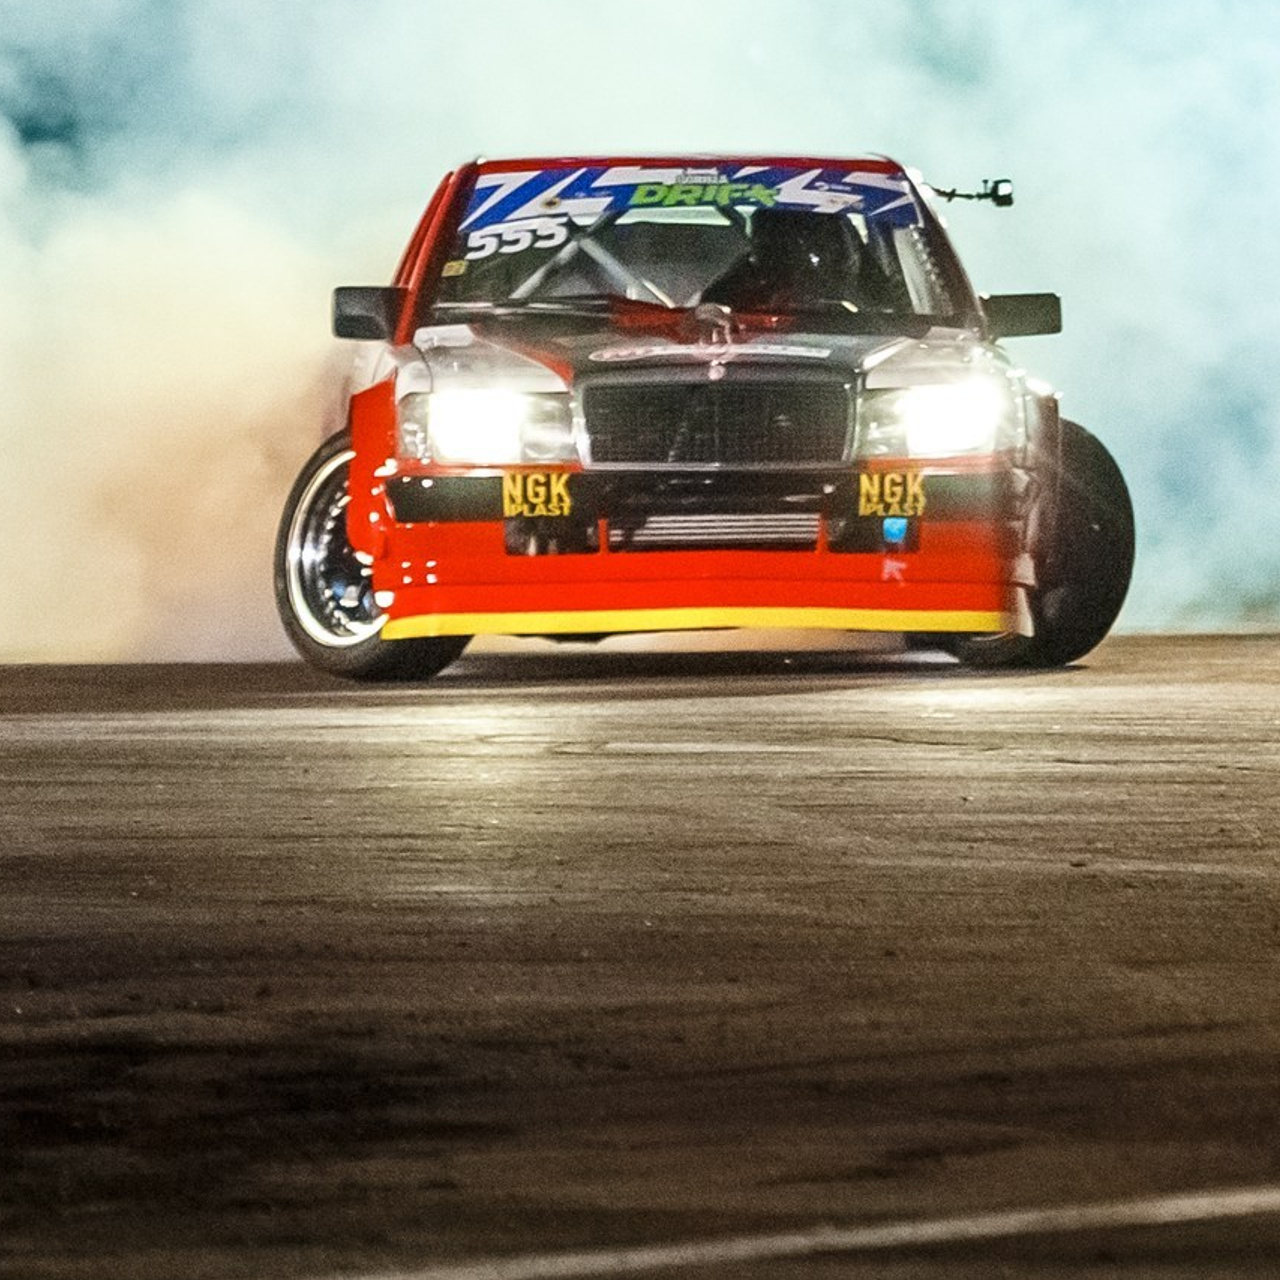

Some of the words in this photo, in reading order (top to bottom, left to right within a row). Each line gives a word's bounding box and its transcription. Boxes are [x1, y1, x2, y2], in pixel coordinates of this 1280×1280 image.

[465, 217, 569, 260] 555
[503, 474, 571, 504] NGK
[859, 473, 926, 503] NGK
